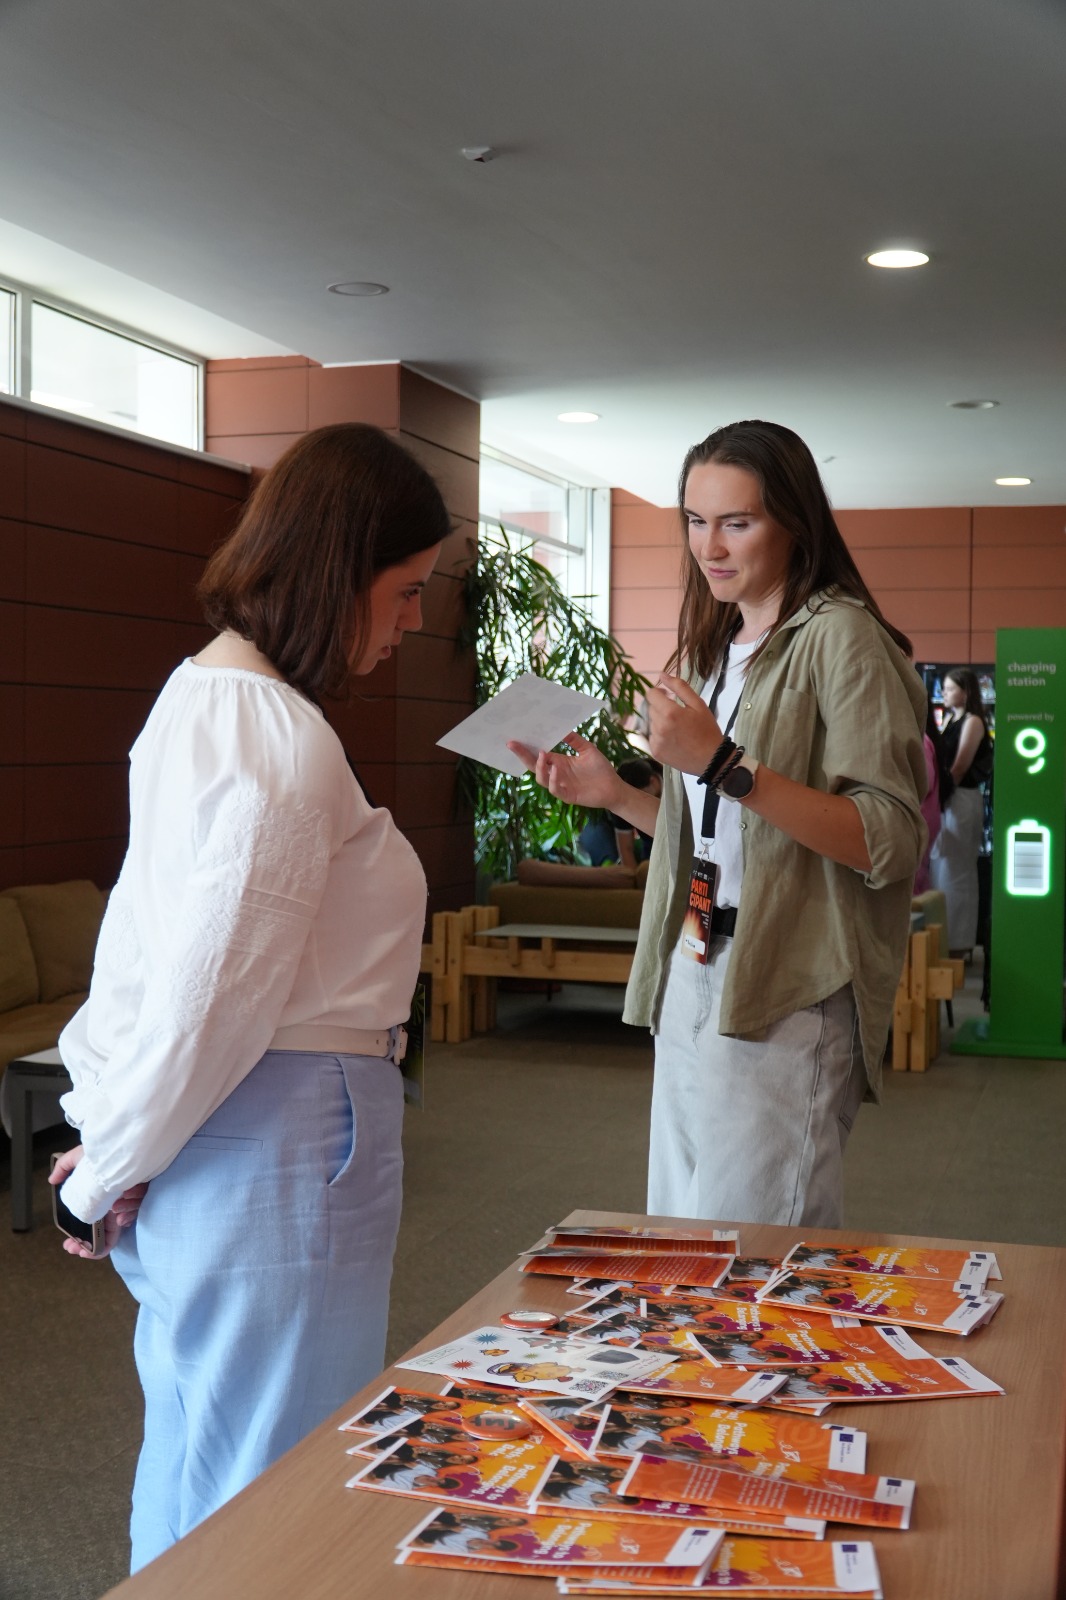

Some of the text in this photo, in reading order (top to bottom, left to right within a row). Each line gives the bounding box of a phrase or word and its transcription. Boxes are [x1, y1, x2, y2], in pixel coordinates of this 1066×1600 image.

[1007, 662, 1056, 674] charging
[1007, 677, 1046, 686] station
[1007, 712, 1055, 722] powered by
[691, 878, 709, 897] PARTI
[690, 893, 711, 913] CIPANT
[786, 1333, 814, 1358] Belonging
[798, 1330, 824, 1354] Pathways
[843, 1366, 876, 1390] Belonging
[854, 1362, 886, 1386] Pathways
[724, 1422, 748, 1454] Pathways
[471, 1465, 517, 1495] Belonging
[494, 1464, 536, 1494] Pathways
